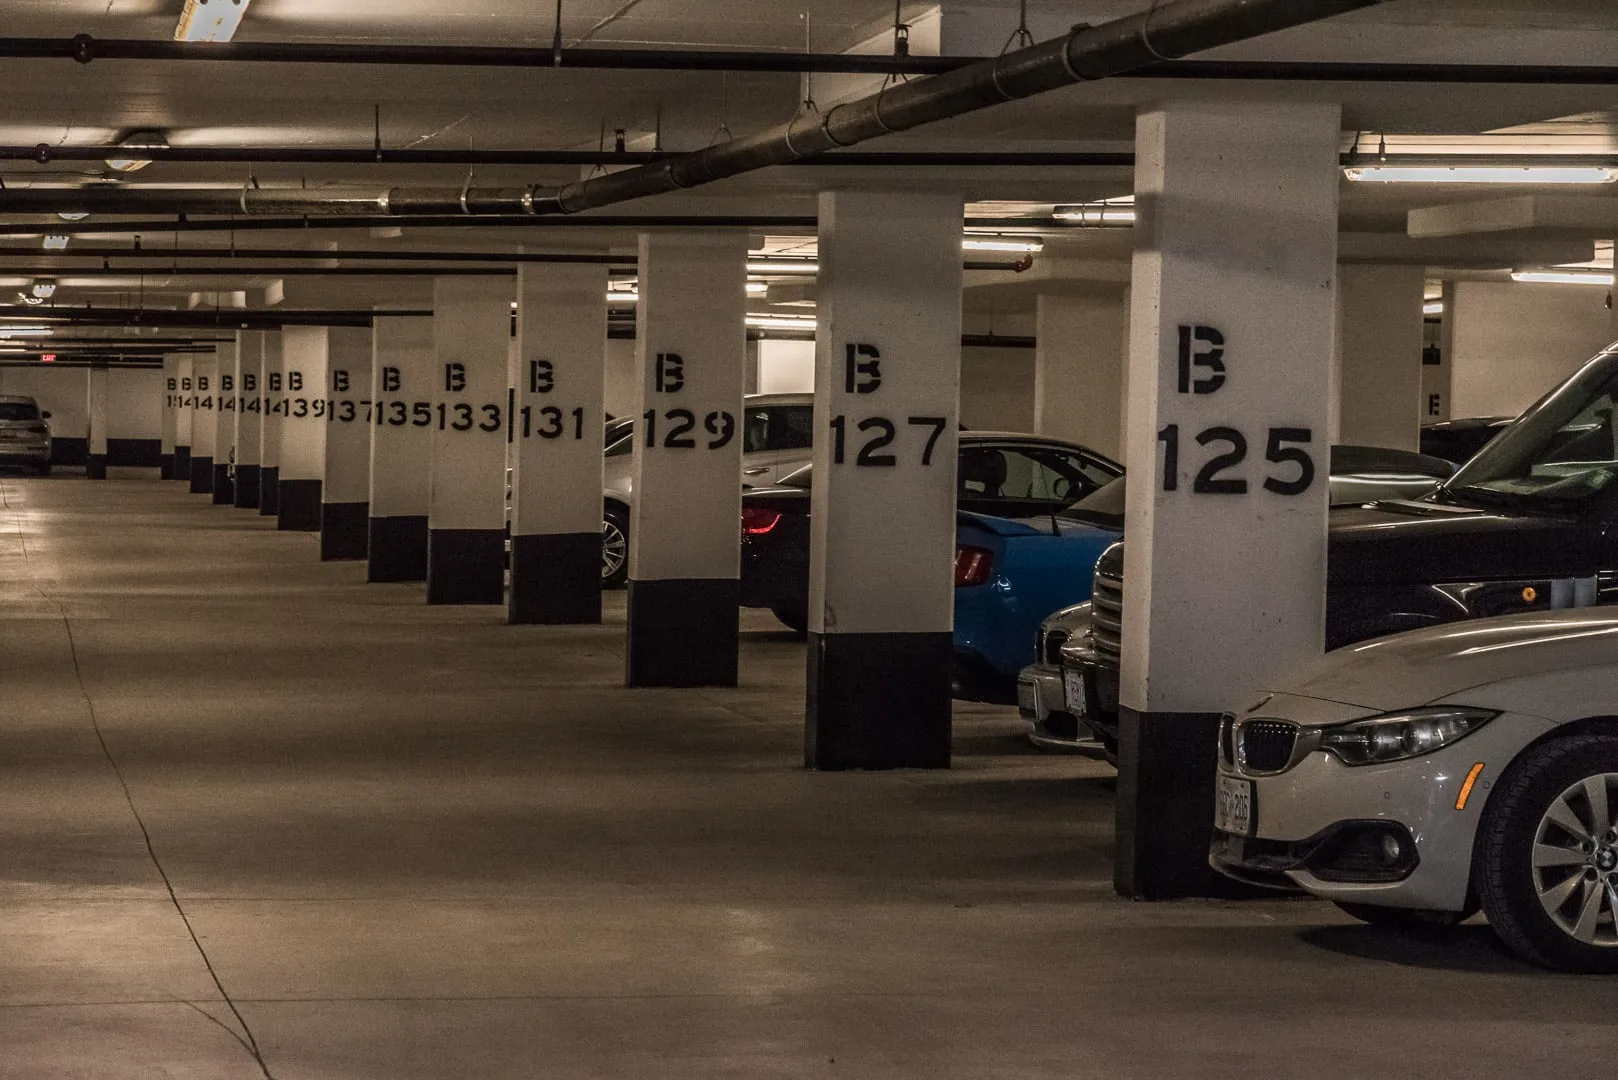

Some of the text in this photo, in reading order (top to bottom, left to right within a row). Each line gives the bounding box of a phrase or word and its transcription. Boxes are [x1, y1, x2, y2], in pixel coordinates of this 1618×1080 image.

[846, 344, 881, 393] B
[1178, 325, 1225, 394] B
[199, 376, 208, 390] B
[222, 375, 233, 390] B
[244, 374, 256, 391] B
[270, 373, 281, 391] B
[289, 372, 302, 391] B
[334, 370, 349, 391] B
[383, 367, 400, 391] B
[446, 363, 465, 391] B
[531, 360, 553, 393] B
[656, 353, 684, 393] B
[168, 378, 176, 390] B
[182, 378, 191, 390] B
[194, 396, 212, 409] 14
[219, 397, 235, 411] 14
[240, 397, 260, 413] 14
[283, 398, 325, 416] 139
[328, 400, 371, 422] 137
[1429, 394, 1439, 415] E
[376, 401, 431, 426] 135
[437, 403, 501, 432] 133
[521, 406, 583, 439] 131
[644, 408, 734, 450] 129
[830, 415, 946, 467] 127
[1158, 424, 1315, 496] 125
